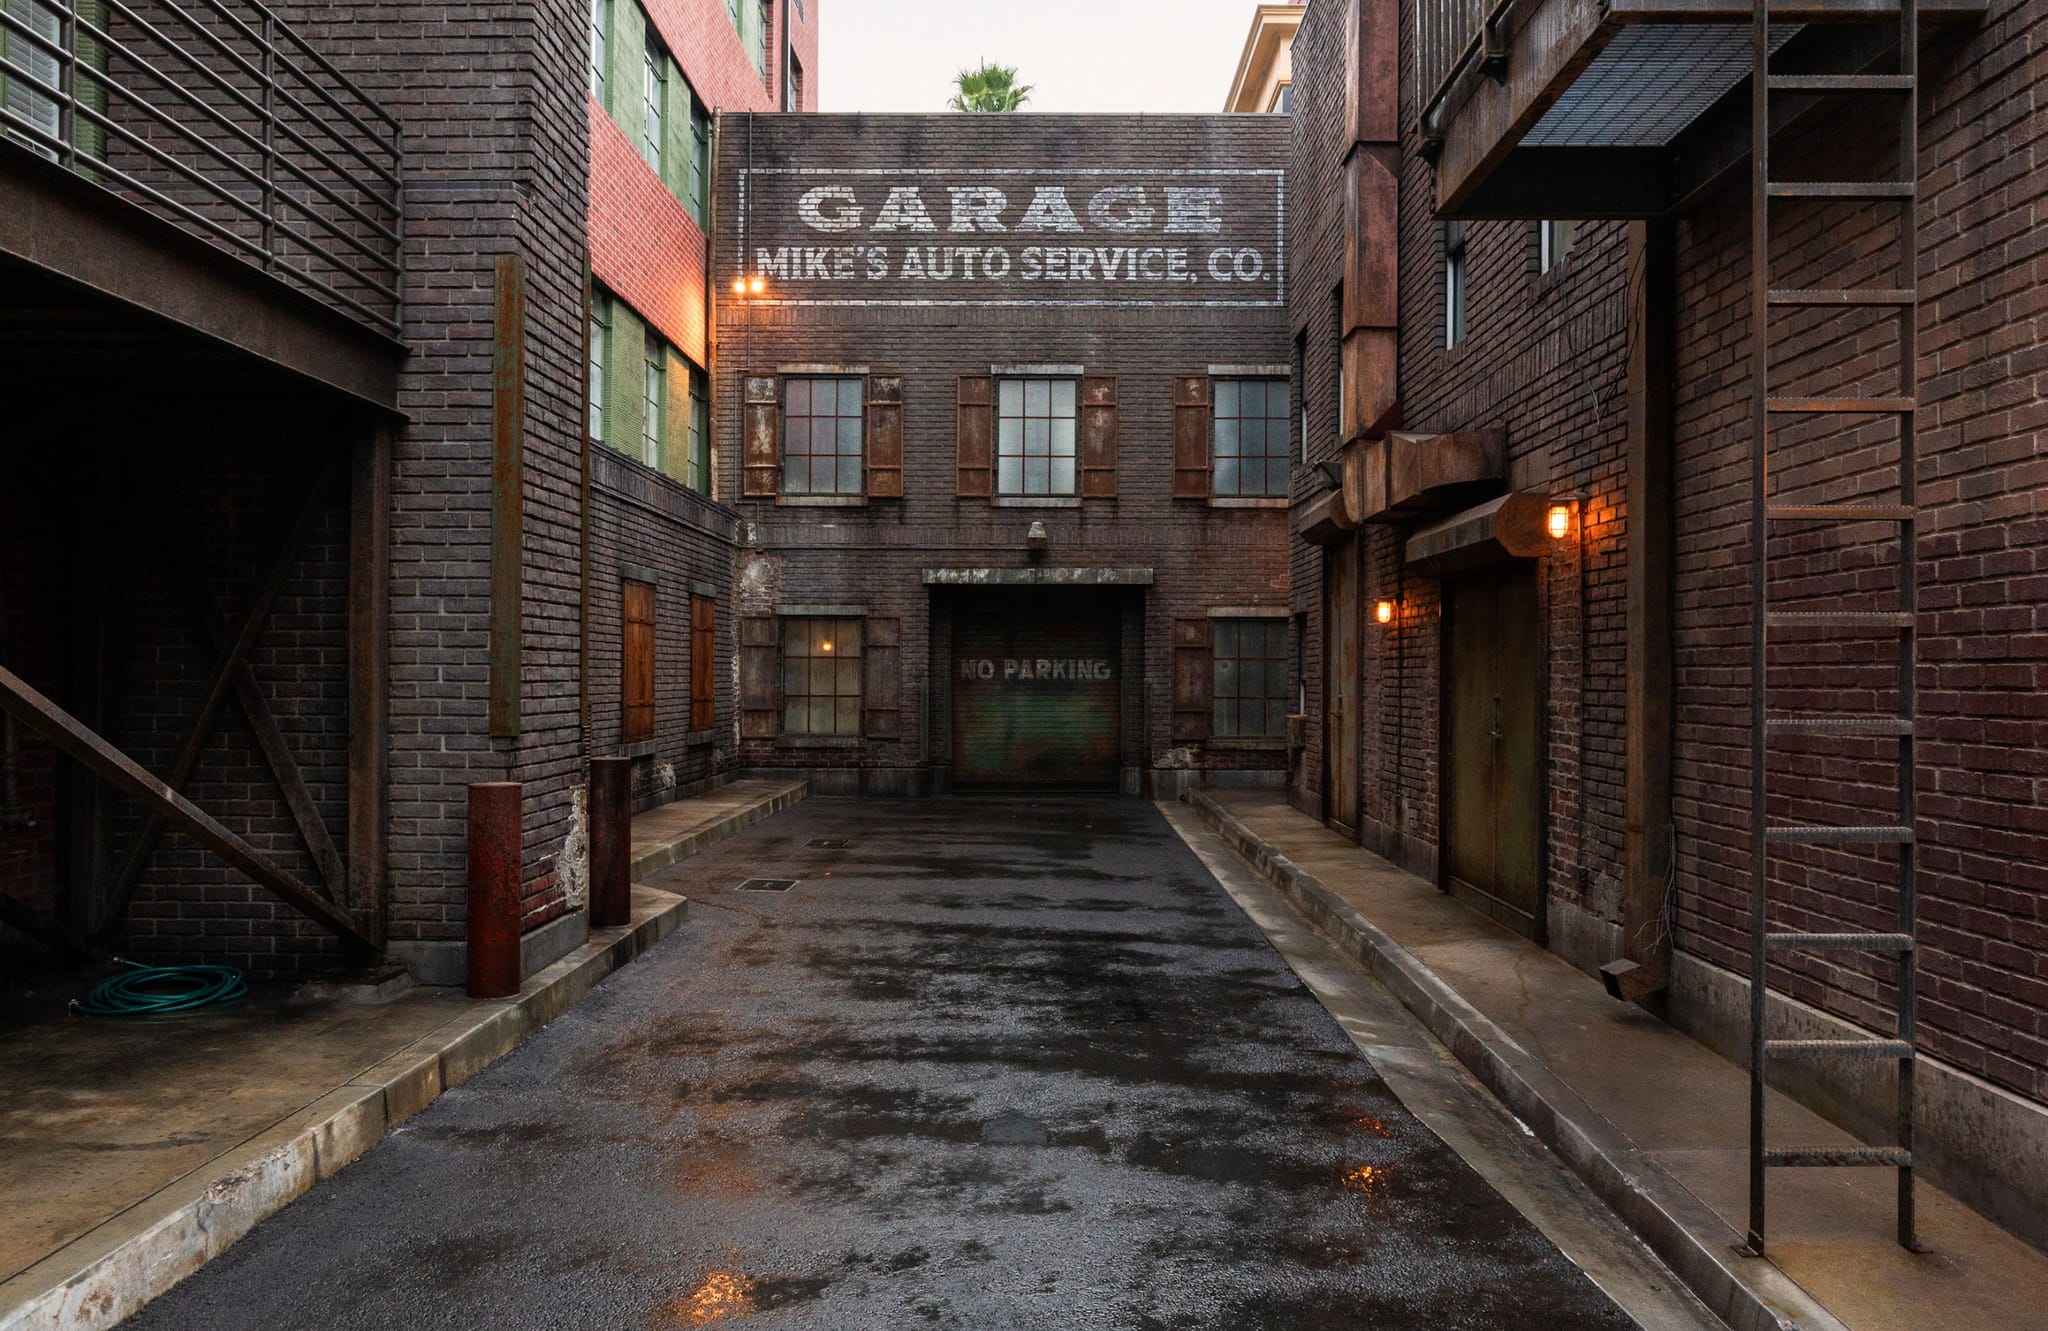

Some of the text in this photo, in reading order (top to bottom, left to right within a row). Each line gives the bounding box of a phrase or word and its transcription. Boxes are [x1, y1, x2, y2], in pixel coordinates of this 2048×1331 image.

[798, 186, 1223, 233] GARAGE
[756, 247, 890, 280] MIKE'S
[900, 246, 1011, 281] AUTO
[1207, 246, 1271, 282] CO.
[961, 659, 1111, 680] NO PARKING
